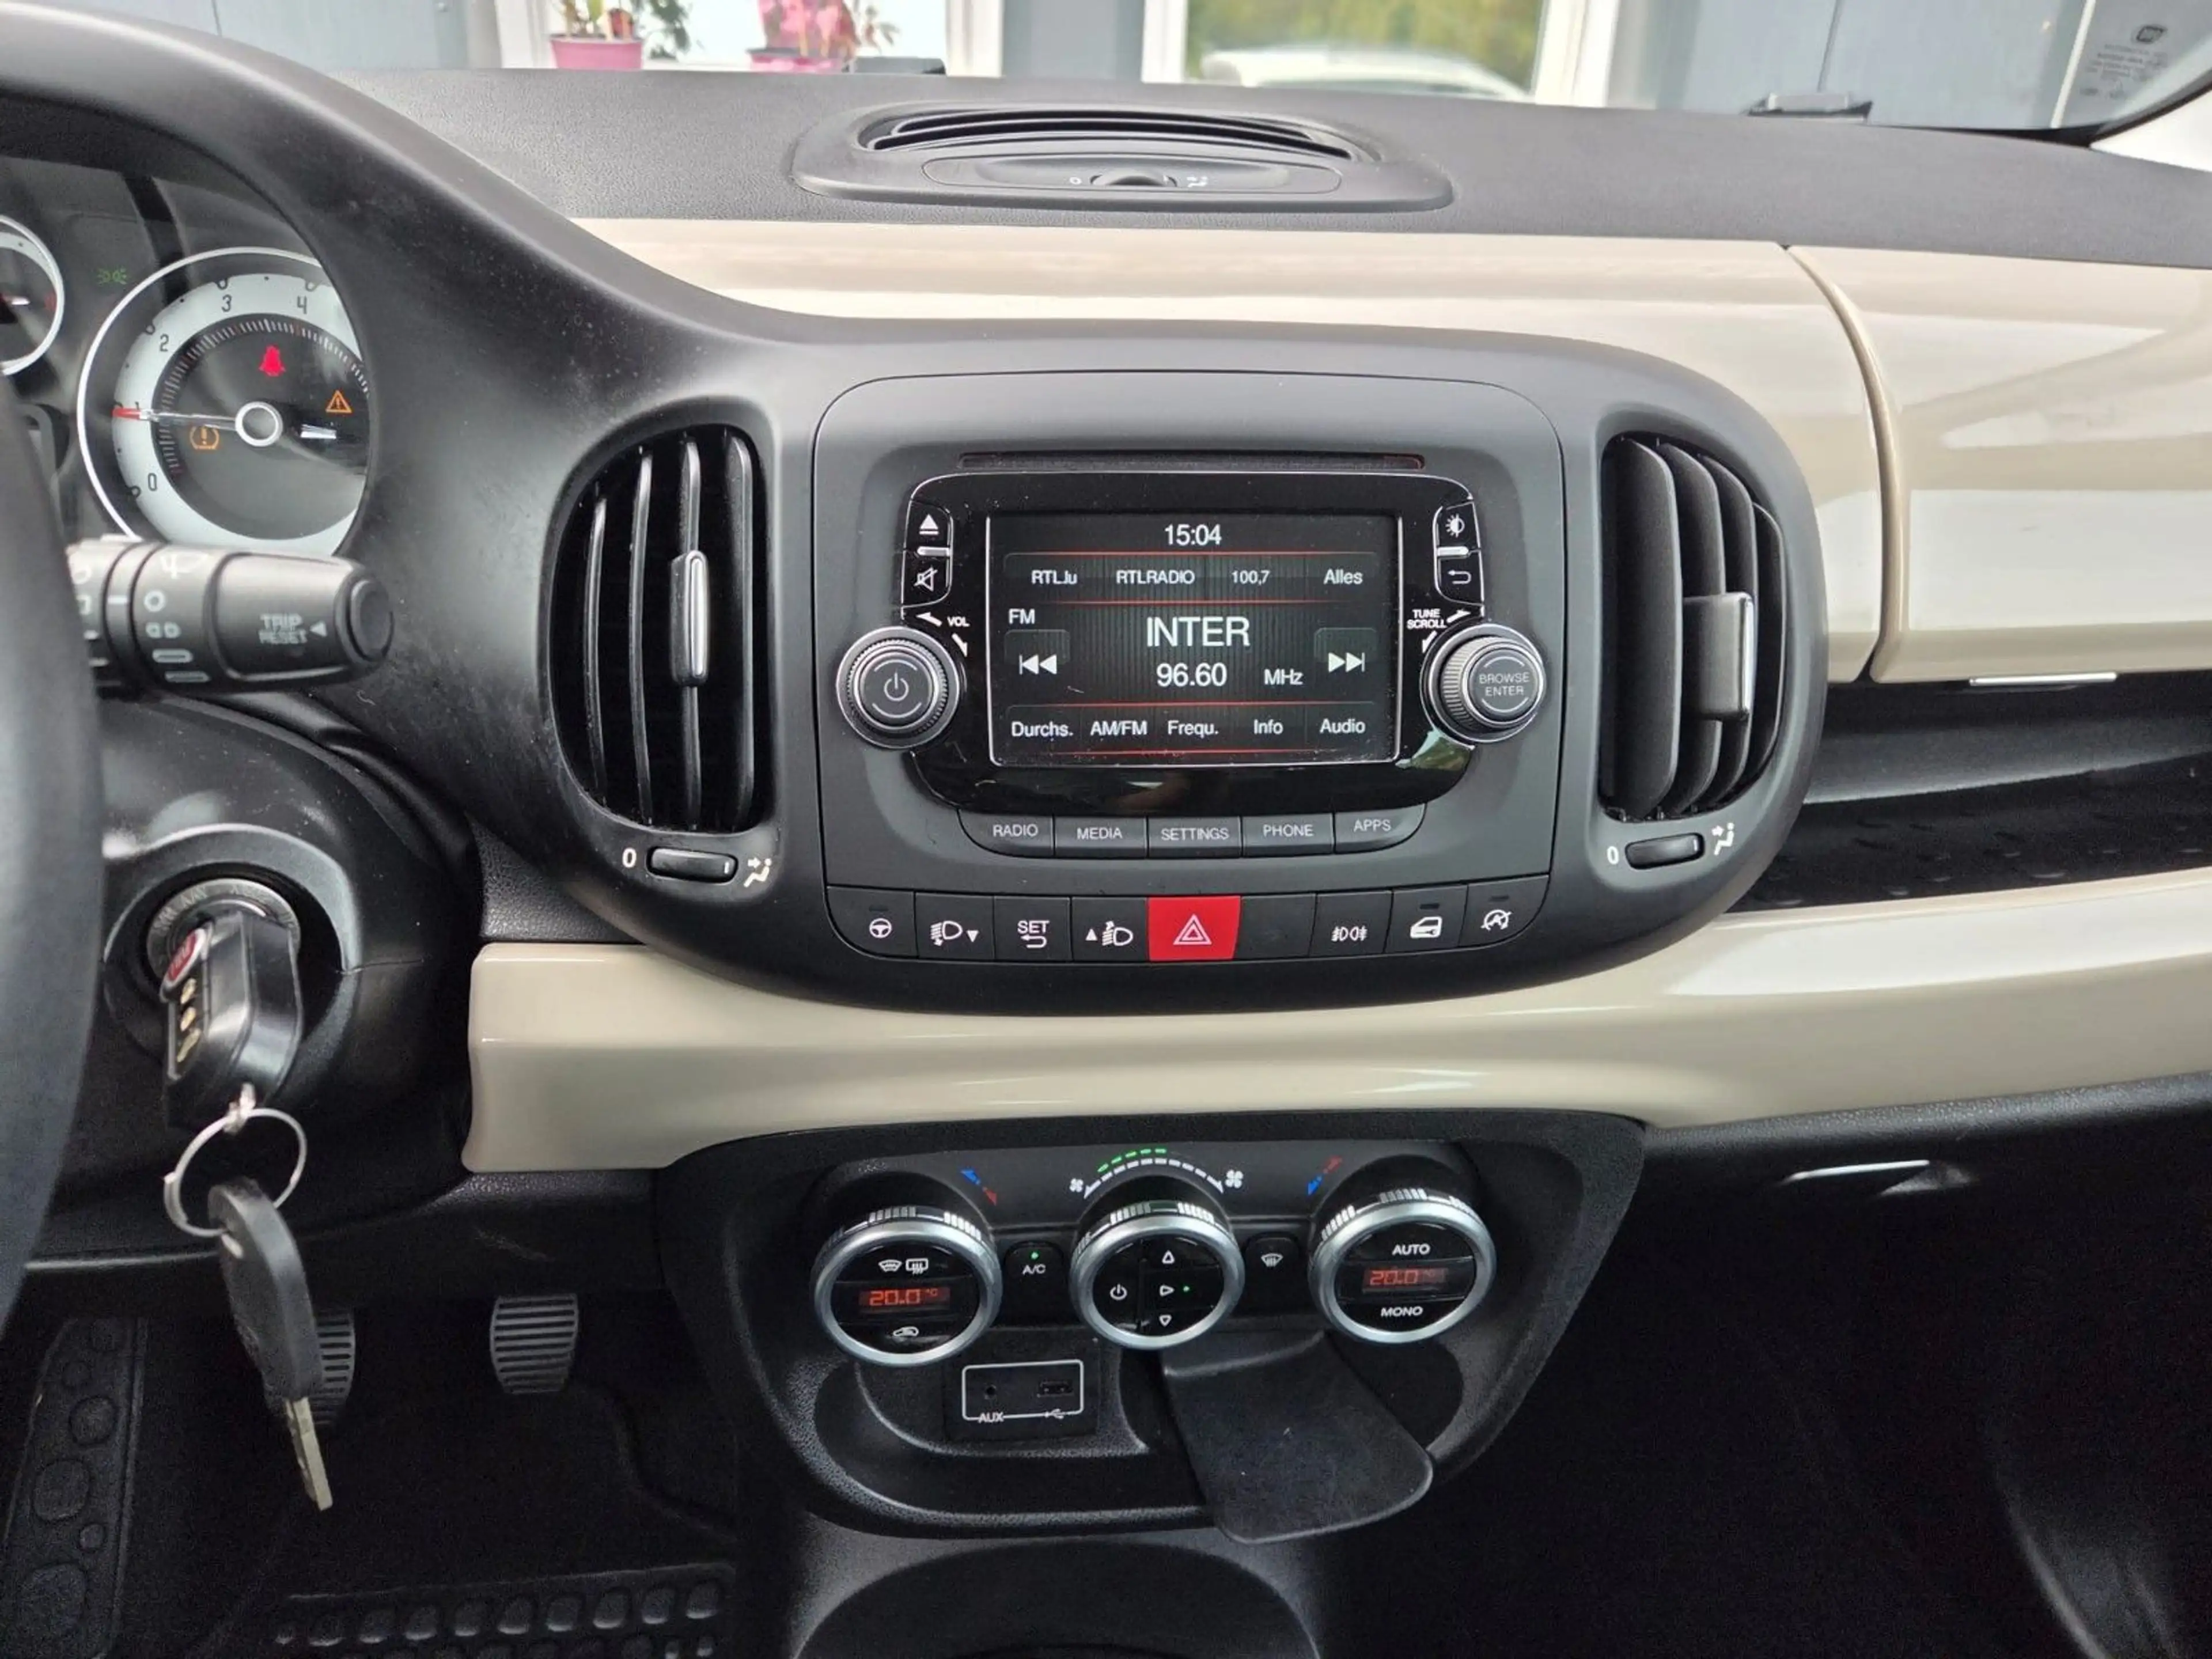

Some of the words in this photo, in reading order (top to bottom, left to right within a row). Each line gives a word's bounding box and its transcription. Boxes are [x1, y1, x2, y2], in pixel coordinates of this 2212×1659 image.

[221, 294, 233, 312] 3
[297, 296, 308, 314] 4
[159, 334, 170, 353] 2
[147, 473, 157, 491] 0
[1164, 524, 1222, 546] 15:04
[1116, 570, 1195, 585] RTLRADIO
[1323, 569, 1363, 585] Alles
[1008, 609, 1035, 624] FM
[1412, 608, 1441, 619] TUNE
[260, 613, 302, 631] TRIP
[947, 616, 970, 627] VOL
[1407, 619, 1447, 630] SCROLL
[1146, 616, 1251, 647] INTER
[1156, 662, 1228, 687] 96.60
[1264, 668, 1303, 685] MHz
[1478, 672, 1530, 684] BROWSE
[1484, 685, 1524, 697] ENTER
[1011, 721, 1074, 737] Durchs.
[1090, 721, 1148, 736] AM/FM
[1167, 720, 1219, 738] Frequ.
[1253, 718, 1284, 734] Info
[1319, 718, 1366, 734] Audio
[993, 824, 1039, 838] RADIO
[1076, 827, 1123, 840] MEDIA
[1262, 823, 1314, 838] PHONE
[1353, 819, 1392, 833] APPS
[1160, 827, 1230, 842] SETTINGS
[622, 847, 637, 869] 0
[1607, 846, 1619, 865] 0
[1017, 920, 1050, 935] SET
[1392, 1243, 1430, 1256] AUTO
[1022, 1264, 1046, 1274] A/C
[1381, 1306, 1423, 1317] MONO
[978, 1411, 1005, 1424] AUX
